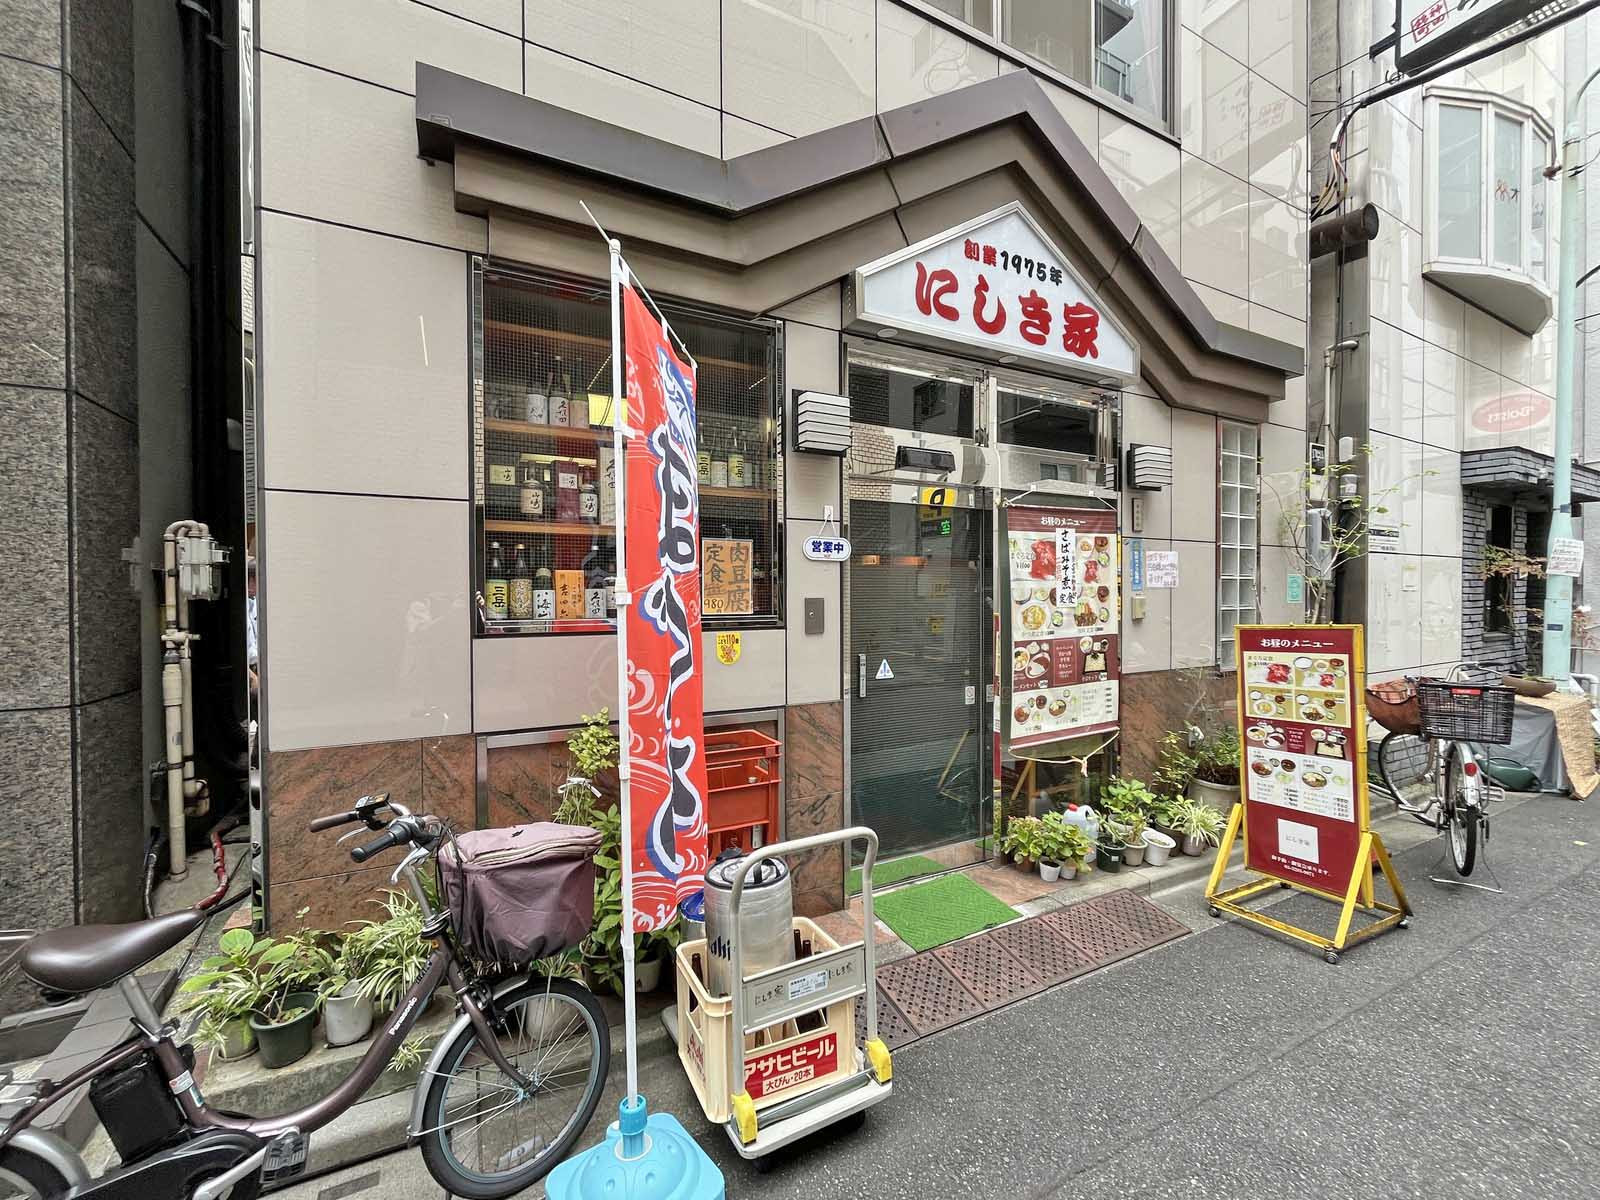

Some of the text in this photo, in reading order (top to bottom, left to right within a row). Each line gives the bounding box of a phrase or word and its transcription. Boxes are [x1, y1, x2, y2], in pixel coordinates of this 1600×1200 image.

[963, 238, 1063, 286] 創業1975年
[914, 261, 1100, 359] にしき家
[1040, 516, 1087, 526] お昼のメニュー
[705, 544, 726, 584] 定食
[811, 541, 844, 554] 営業中
[725, 543, 750, 613] 肉豆腐
[703, 598, 724, 609] 980
[1260, 638, 1334, 648] お昼のメニュー
[388, 997, 418, 1035] Panasonic
[745, 1039, 835, 1082] アサヒビール
